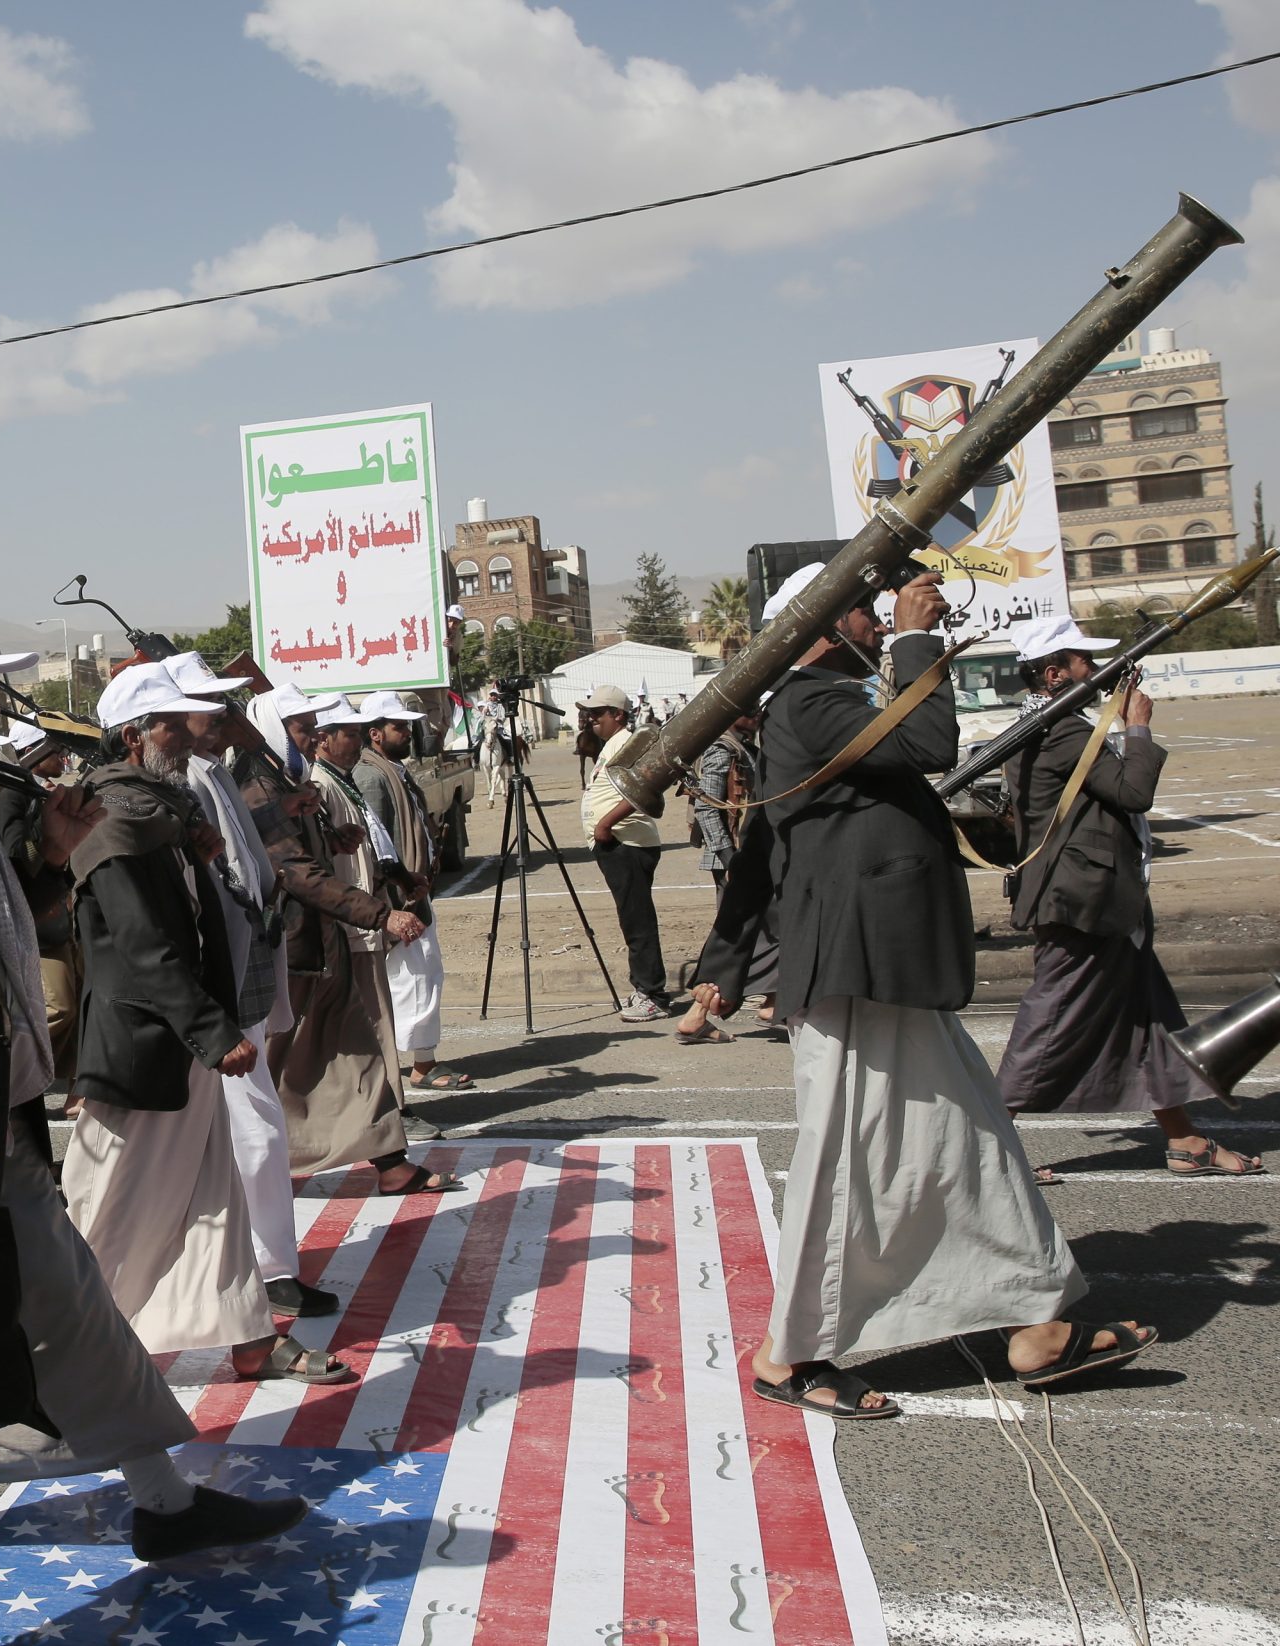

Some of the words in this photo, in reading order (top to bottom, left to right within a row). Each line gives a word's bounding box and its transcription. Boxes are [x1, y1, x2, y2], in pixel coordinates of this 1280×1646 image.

[258, 437, 417, 507] قاطعوا
[262, 509, 344, 565] الأمريكية
[349, 508, 421, 559] البضائع
[336, 571, 347, 605] و
[953, 555, 1009, 578] التعبئة
[270, 615, 429, 671] الإسرائيلية
